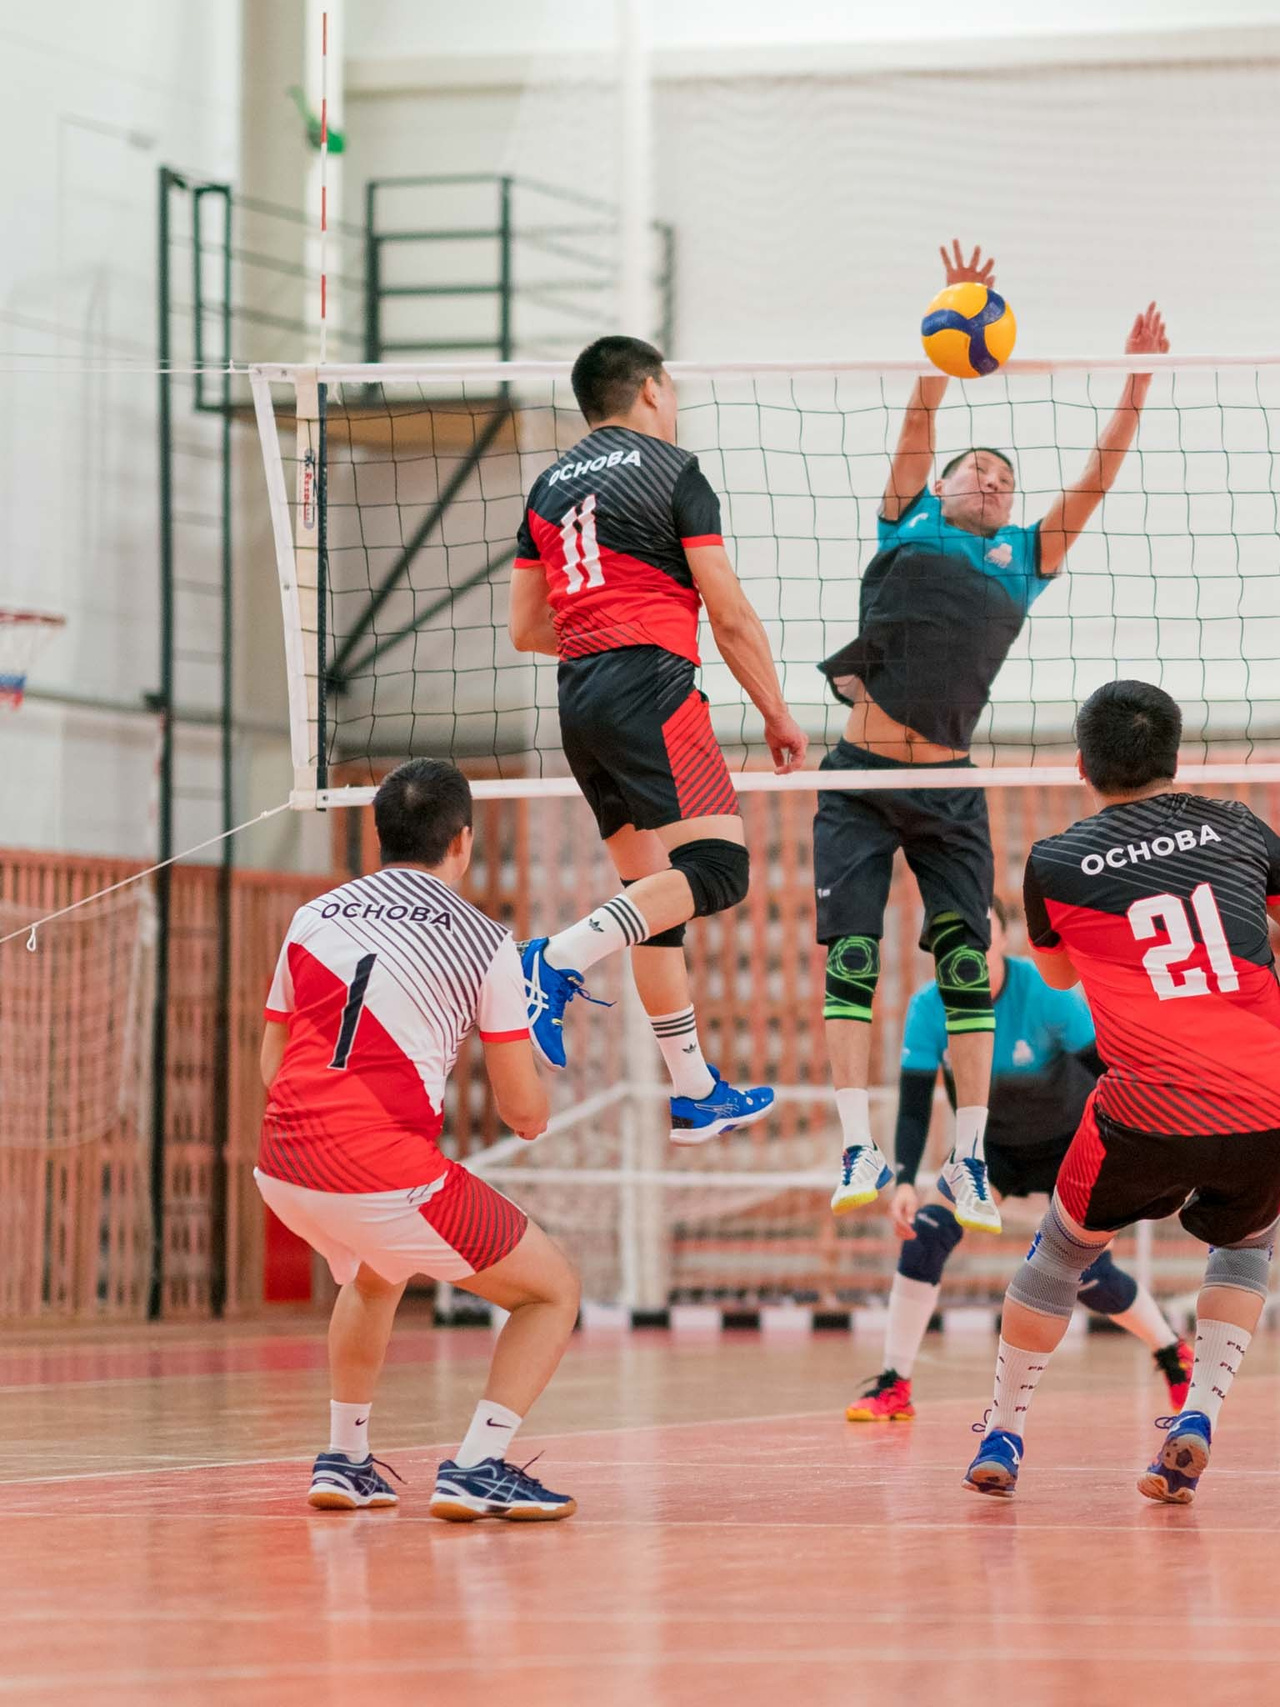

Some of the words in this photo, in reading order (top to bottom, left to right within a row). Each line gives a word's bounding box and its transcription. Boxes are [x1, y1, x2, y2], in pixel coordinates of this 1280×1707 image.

[549, 450, 641, 486] ОСНОВА
[560, 494, 606, 595] 11
[1080, 824, 1223, 876] ОСНОВА
[321, 902, 454, 931] ОСНОВА
[1127, 882, 1240, 1001] 21
[329, 953, 377, 1070] 1
